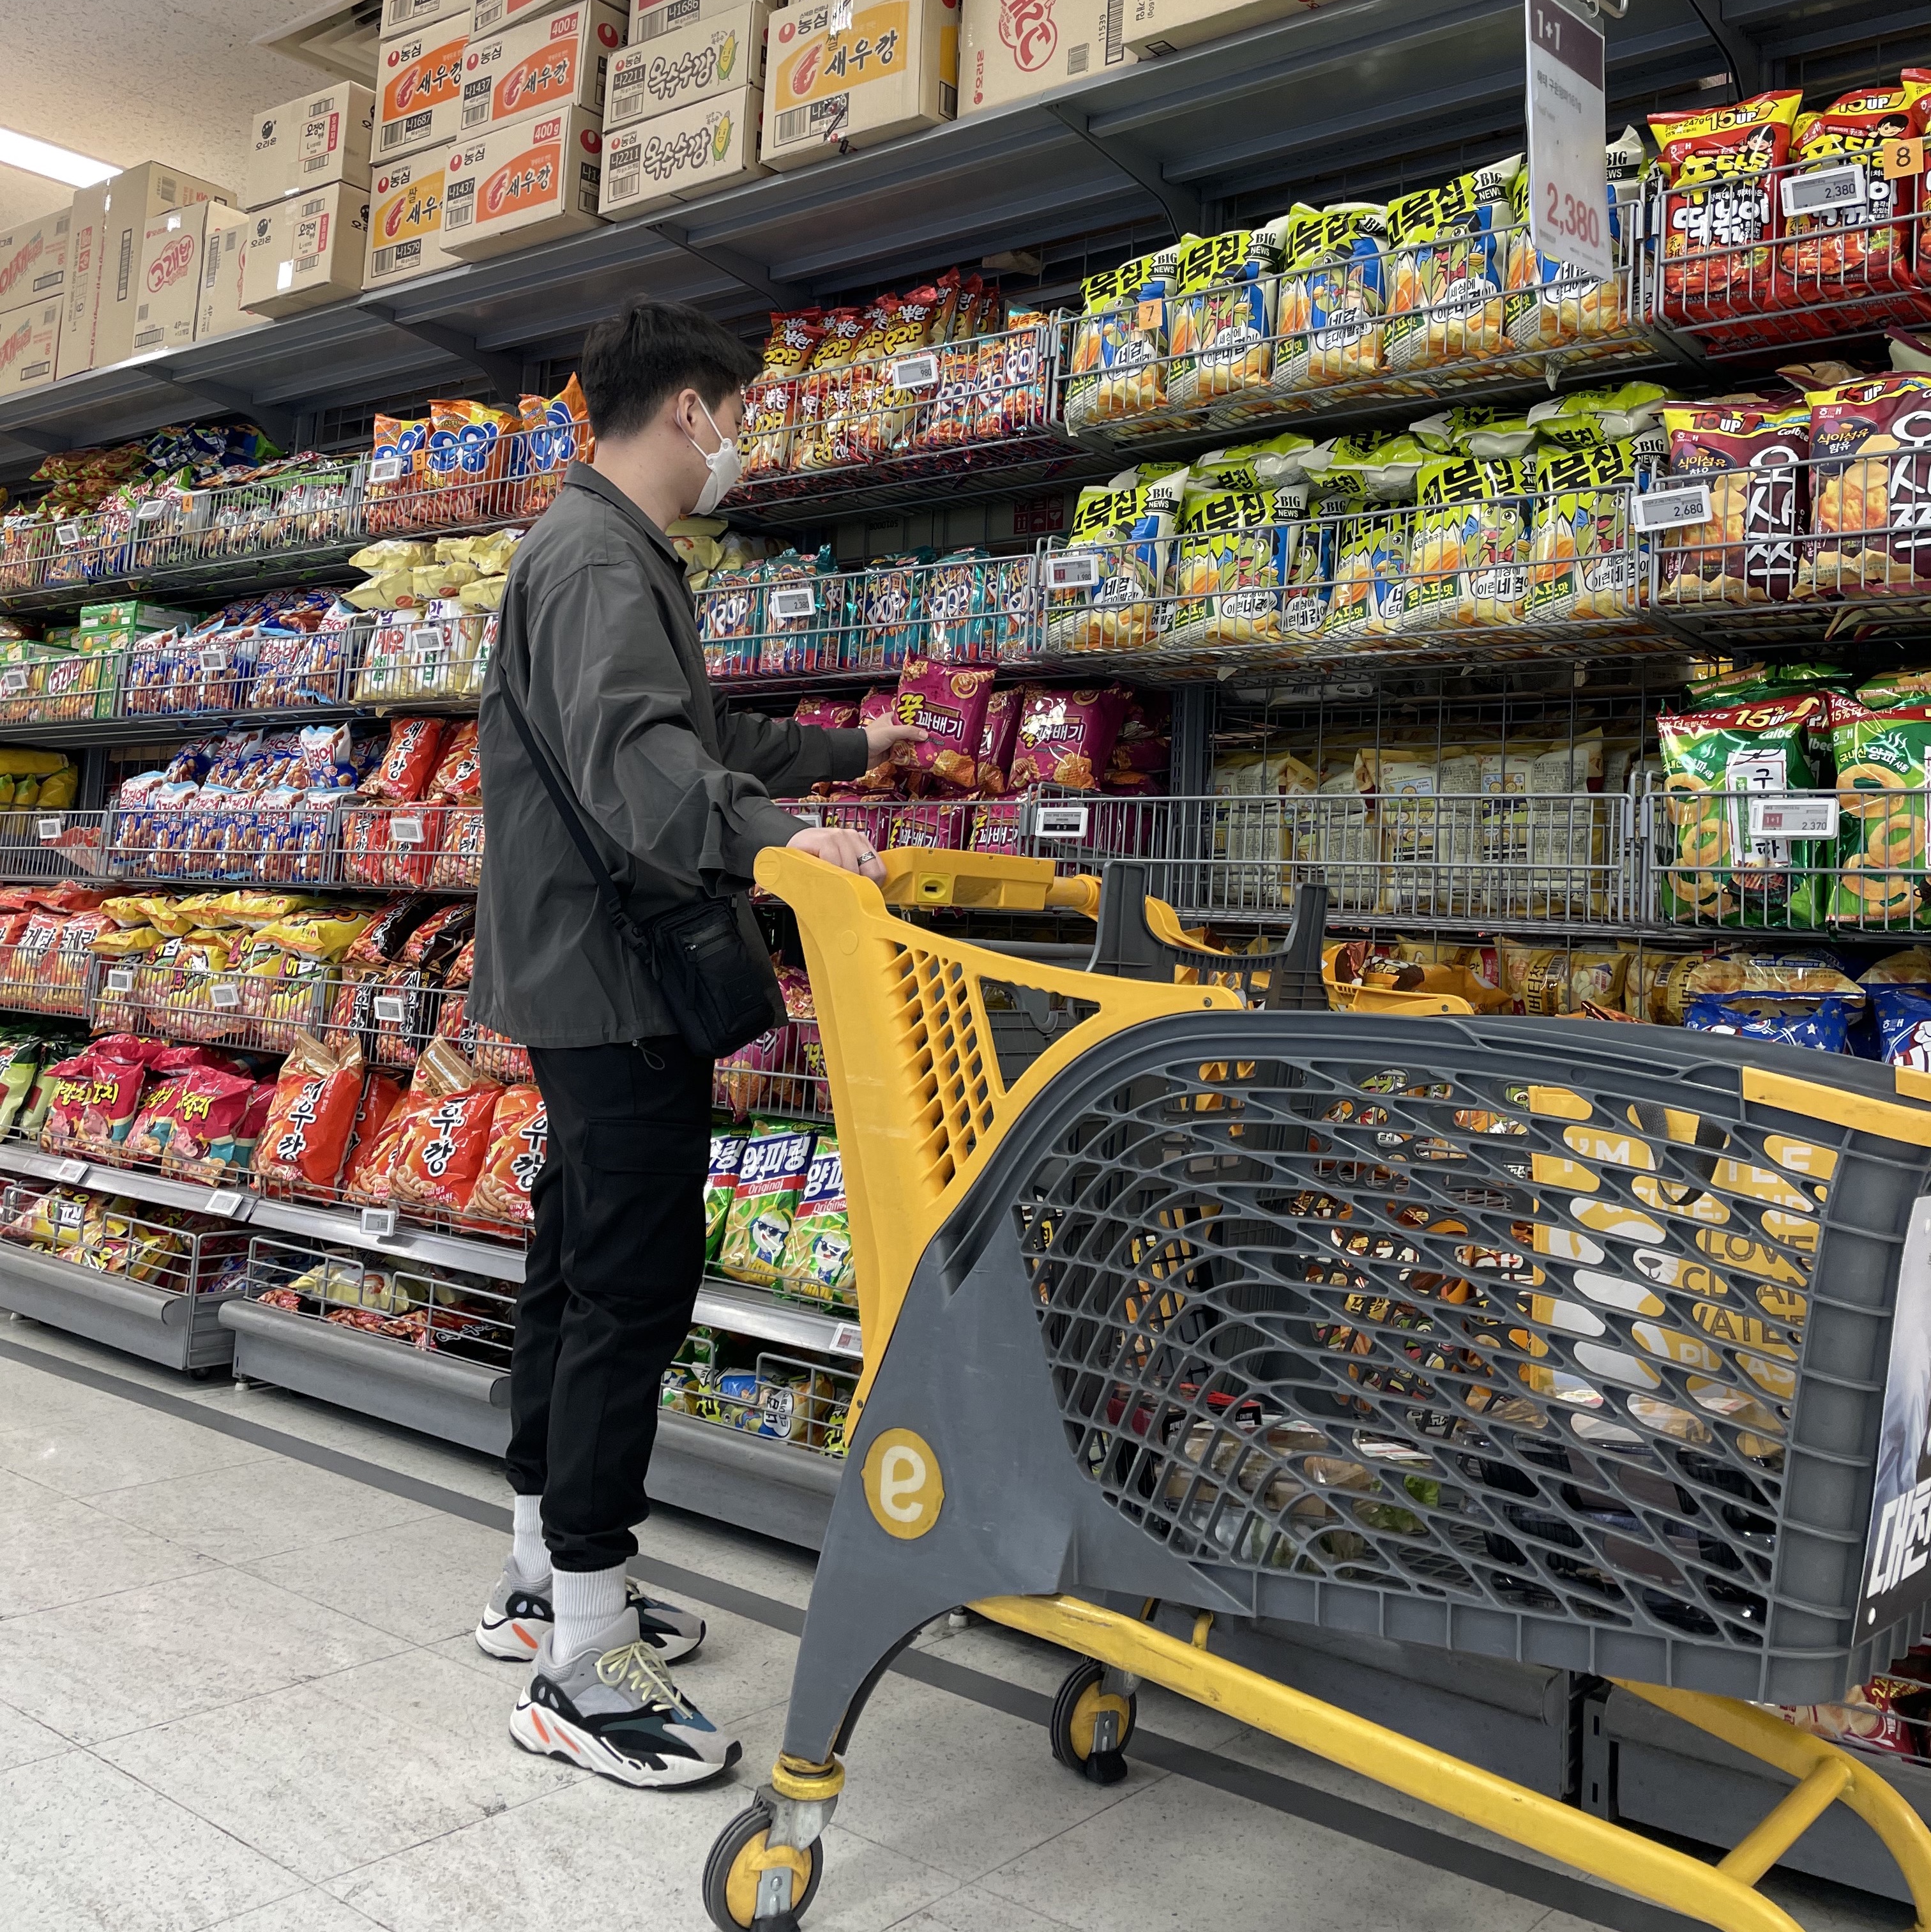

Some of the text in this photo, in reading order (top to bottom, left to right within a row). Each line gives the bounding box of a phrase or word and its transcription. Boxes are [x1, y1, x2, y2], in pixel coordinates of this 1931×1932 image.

[798, 10, 829, 35] 농심
[1536, 10, 1561, 51] 1+1
[826, 33, 840, 51] 쌀
[400, 43, 422, 62] 농심
[480, 45, 503, 65] 농심
[625, 55, 641, 68] 농심
[824, 30, 898, 77] 새우깡
[522, 59, 568, 93] 새우깡
[614, 68, 644, 87] 나2211
[647, 47, 716, 101] 옥수수깡
[465, 79, 490, 96] 나1437
[1867, 96, 1889, 110] UP
[407, 113, 432, 129] 나1687
[1735, 110, 1757, 125] UP
[305, 119, 326, 137] 오징어
[255, 137, 277, 151] 오리온
[621, 135, 637, 147] 농심
[464, 147, 486, 167] 농심
[610, 149, 639, 167] 나2211
[643, 127, 711, 181] 옥수수깡
[1896, 146, 1911, 168] 8
[390, 170, 411, 188] 농심
[506, 165, 552, 198] 새우깡
[1480, 171, 1503, 186] BIG
[407, 187, 417, 204] 쌀
[448, 180, 475, 197] 나1437
[406, 196, 444, 225] 새우
[1547, 182, 1600, 248] 2,380
[250, 234, 271, 248] 오리온
[396, 240, 421, 257] 나1579
[1255, 232, 1276, 247] BIG
[1158, 252, 1178, 265] BIG
[1250, 246, 1270, 257] NEWS
[1153, 264, 1175, 275] NEWS
[1146, 305, 1155, 323] 7
[883, 322, 923, 356] POP
[813, 338, 851, 369] POP
[1864, 384, 1885, 402] UP
[1719, 417, 1740, 433] UP
[1817, 427, 1870, 445] 식이섬유
[1639, 438, 1665, 453] BIG
[1828, 440, 1851, 454] 함유
[416, 452, 422, 466] 5
[1677, 455, 1727, 469] 식이섬유
[1152, 486, 1173, 499] BIG
[1280, 494, 1301, 509] BIG
[1148, 500, 1170, 509] NEWS
[1277, 508, 1299, 519] NEWS
[1326, 499, 1346, 512] BIG
[1674, 502, 1704, 517] 2,680
[1407, 583, 1454, 607] 콘스프맛
[897, 694, 924, 726] 꿀
[1830, 708, 1851, 722] 15%
[916, 711, 963, 739] 꽈배기
[388, 720, 426, 780] 새우깡
[1808, 738, 1833, 751] lbee
[1868, 746, 1900, 765] 양파
[1893, 762, 1910, 773] 사용
[739, 1136, 812, 1180] 양파링
[748, 1180, 782, 1196] Original
[1704, 1228, 1814, 1265] LOVE
[879, 1445, 926, 1523] e
